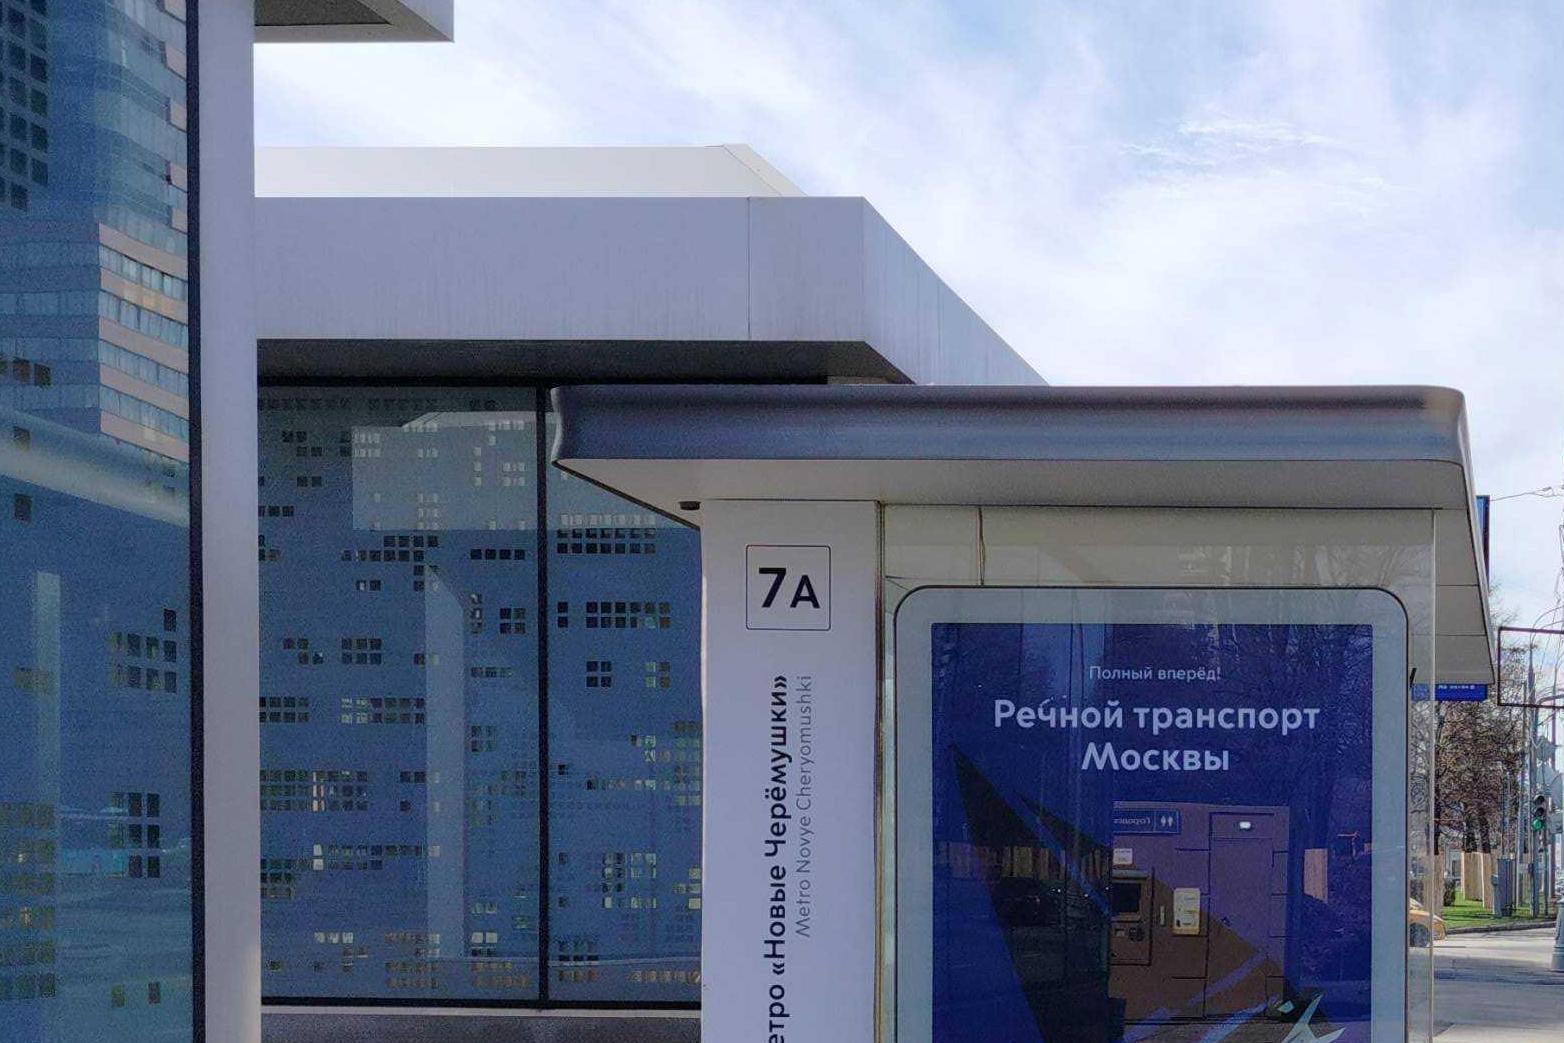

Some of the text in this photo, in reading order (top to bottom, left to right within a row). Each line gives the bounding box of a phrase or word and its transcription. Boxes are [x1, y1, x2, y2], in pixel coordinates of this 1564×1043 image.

[758, 567, 820, 609] 7А
[1088, 664, 1222, 682] Полный вперёд!
[993, 699, 1321, 736] Речной транспорт
[764, 675, 793, 858] Черёмушки»
[1080, 742, 1230, 771] Москвы
[795, 675, 815, 938] Metro Novye Cheryomushki
[763, 864, 787, 976] «Новые
